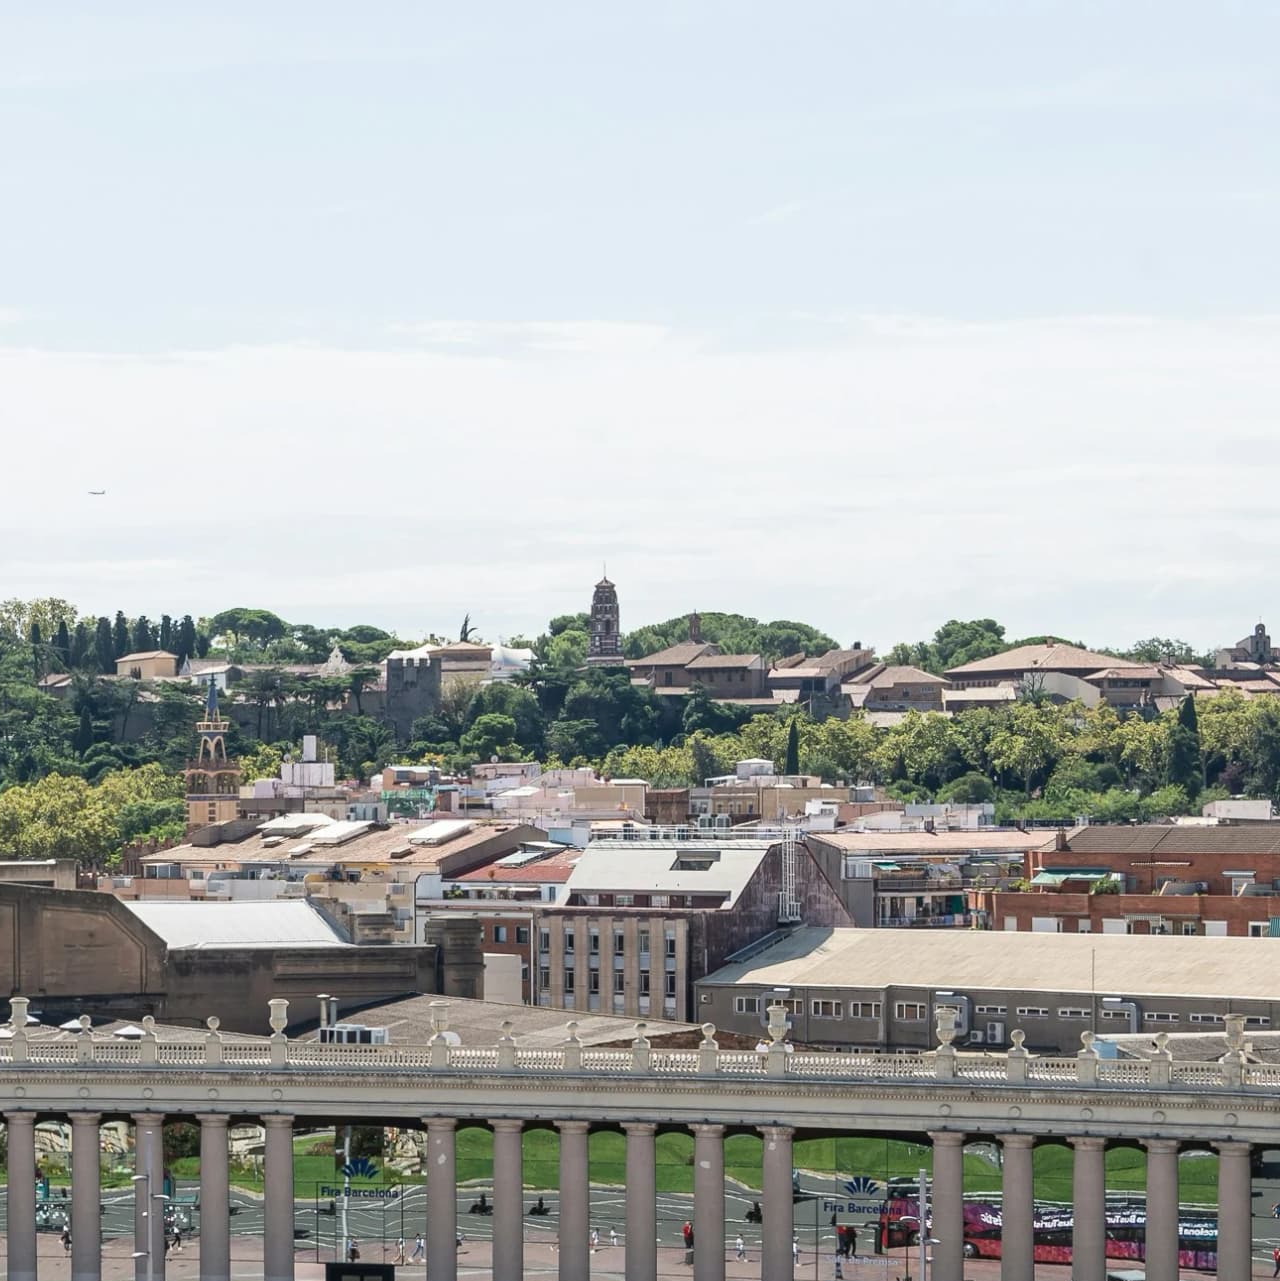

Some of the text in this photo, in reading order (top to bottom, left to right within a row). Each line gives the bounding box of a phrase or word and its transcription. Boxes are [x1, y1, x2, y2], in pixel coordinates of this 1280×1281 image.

[321, 1185, 399, 1198] Fira Barcelona
[823, 1201, 902, 1215] Fira Barcelona
